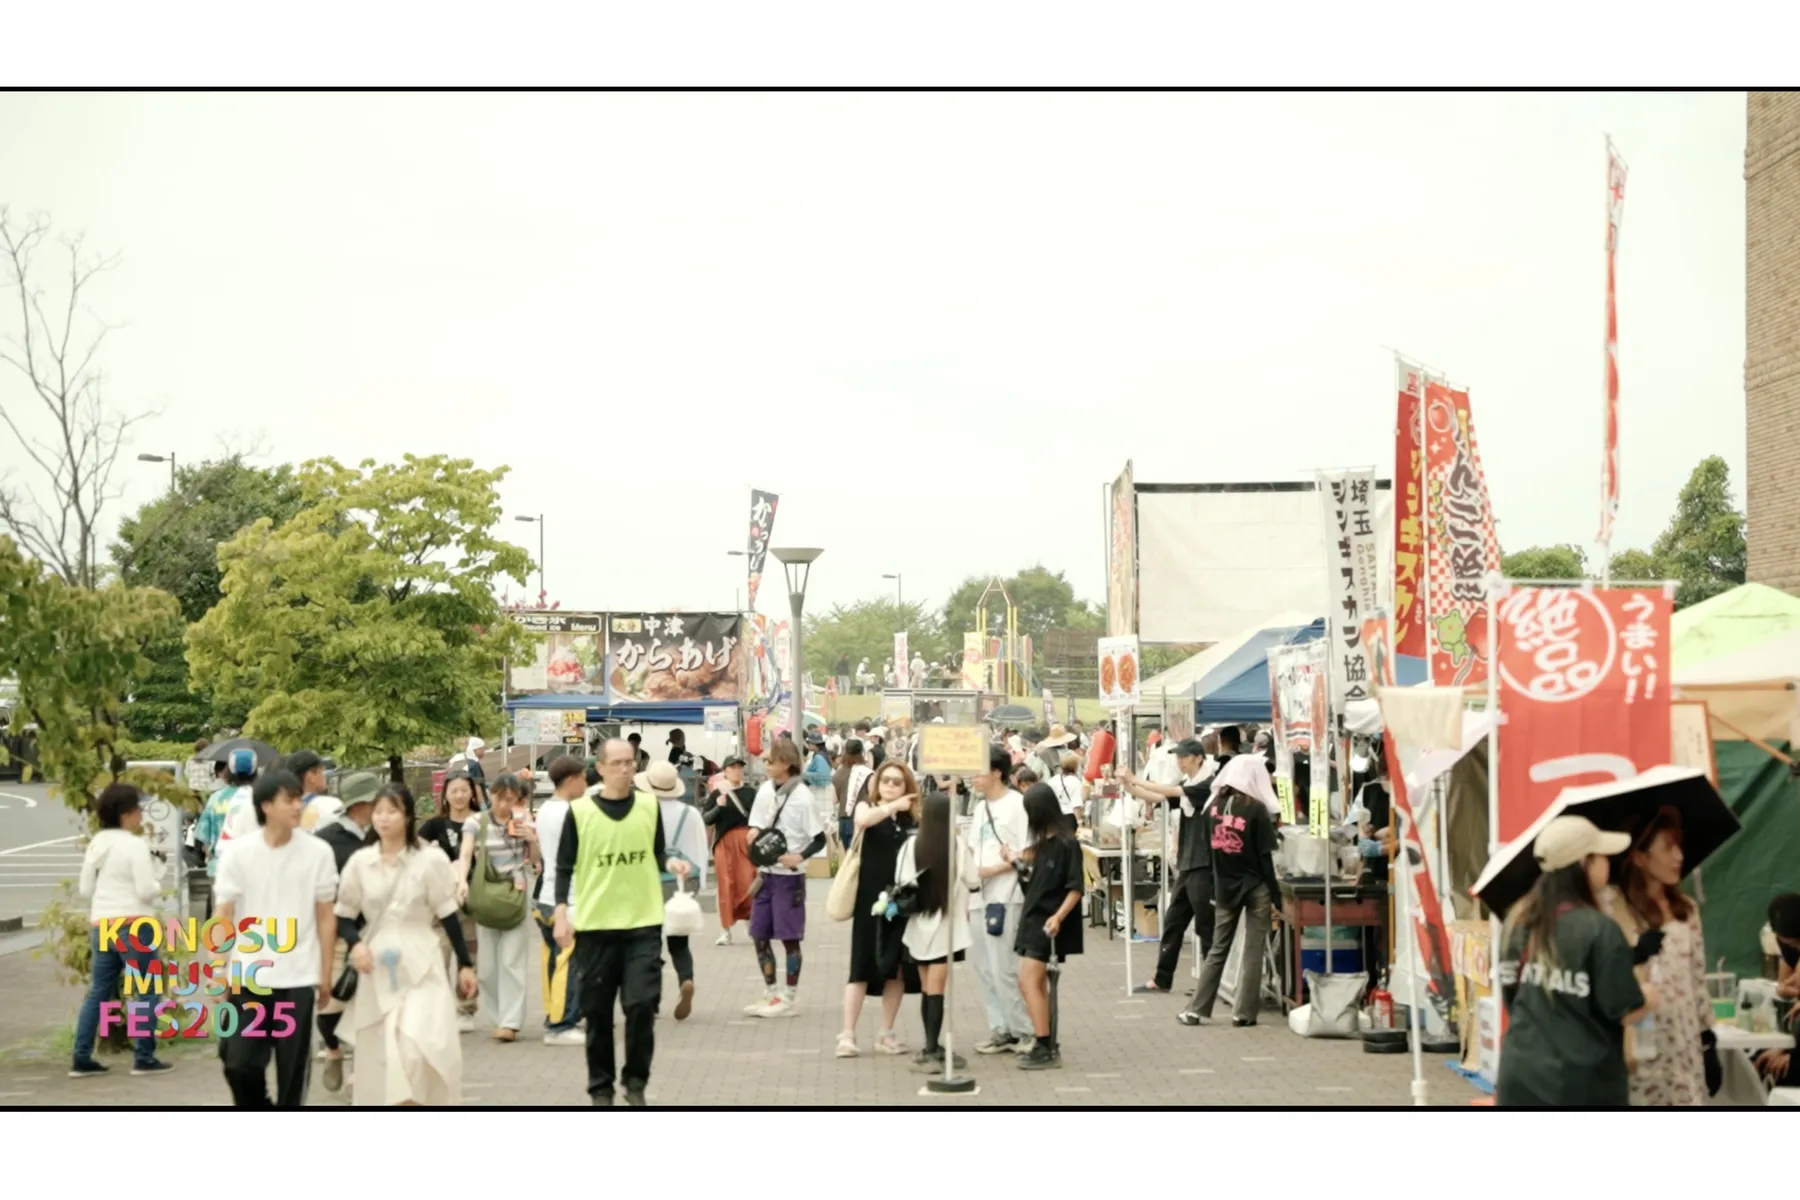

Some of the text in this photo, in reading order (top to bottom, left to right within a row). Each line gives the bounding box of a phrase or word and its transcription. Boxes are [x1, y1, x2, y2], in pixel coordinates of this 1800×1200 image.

[1351, 478, 1373, 537] 埼玉
[643, 616, 685, 637] 中津
[1500, 589, 1599, 697] 絶品
[616, 636, 738, 673] からあげ
[597, 850, 647, 867] STAFF
